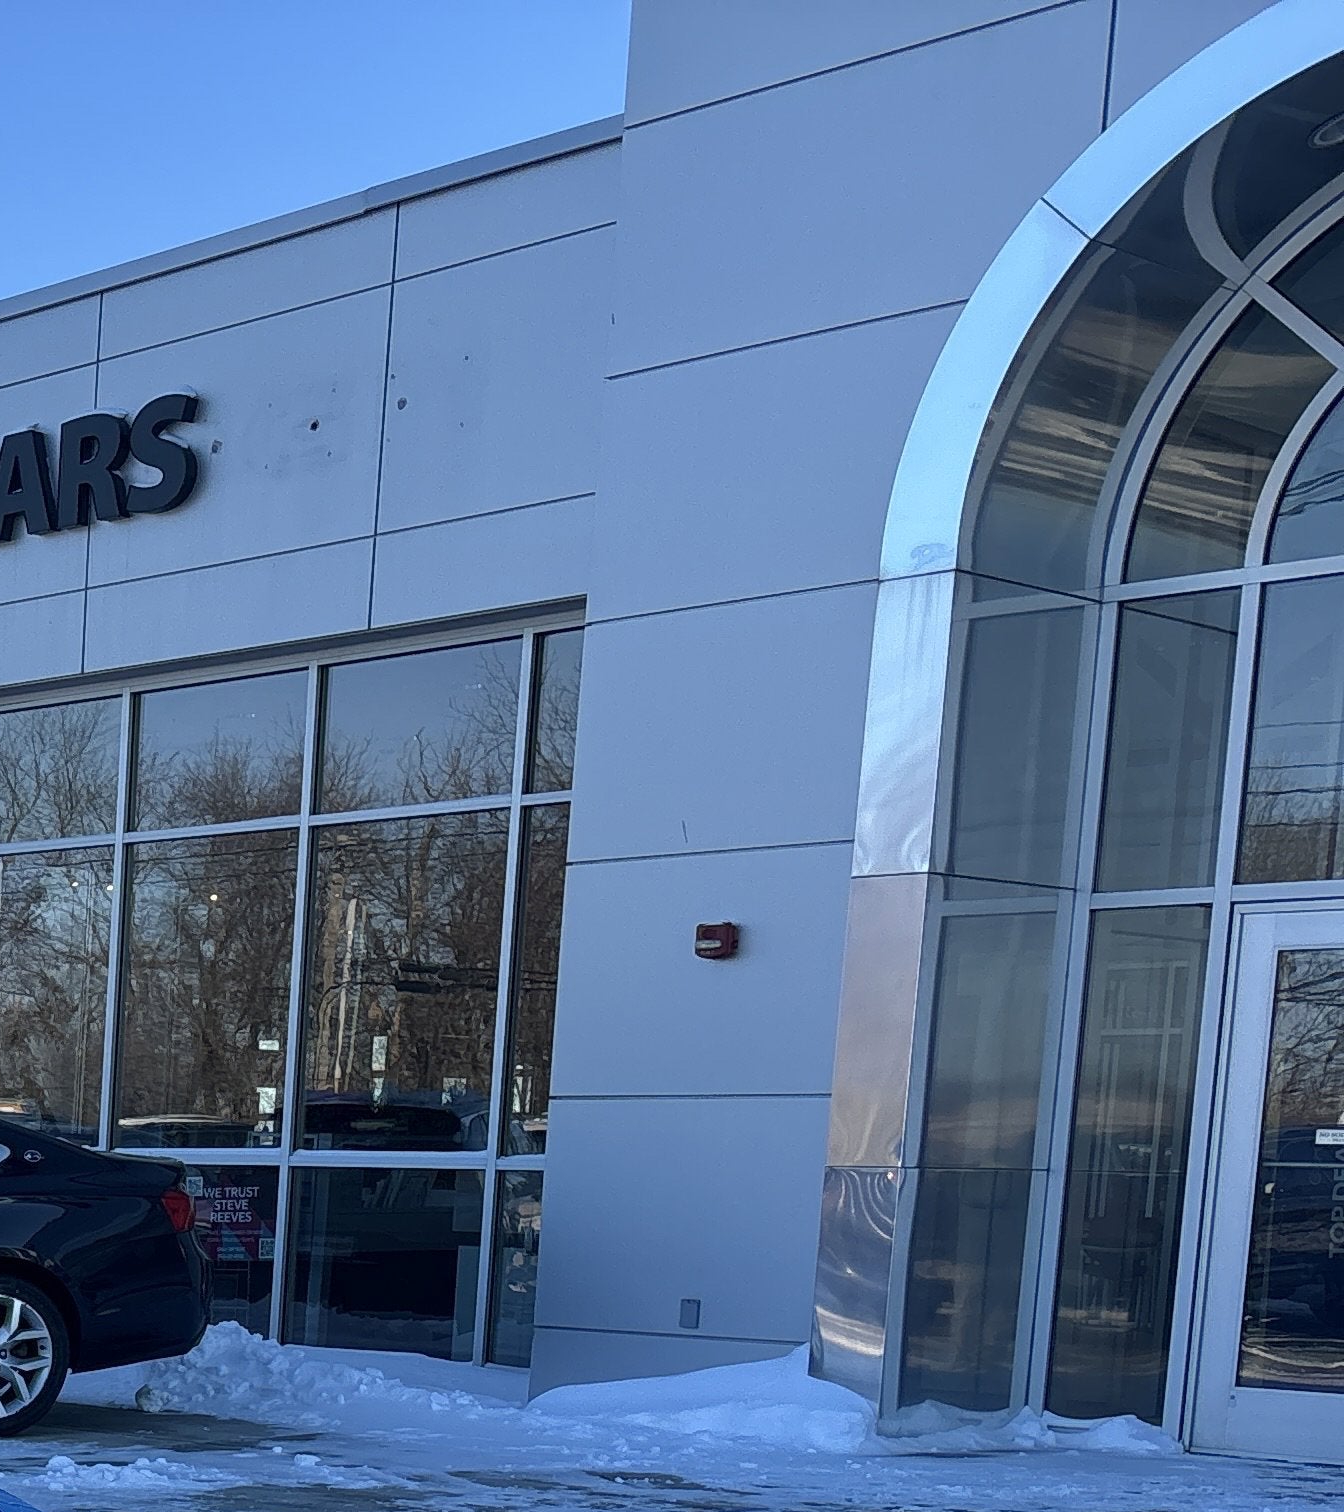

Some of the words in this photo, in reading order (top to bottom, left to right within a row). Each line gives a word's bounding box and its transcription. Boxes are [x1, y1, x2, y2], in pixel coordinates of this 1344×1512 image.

[203, 1187, 222, 1199] WE
[223, 1186, 260, 1198] TRUST
[213, 1199, 249, 1211] STEVE
[210, 1211, 253, 1223] REEVES
